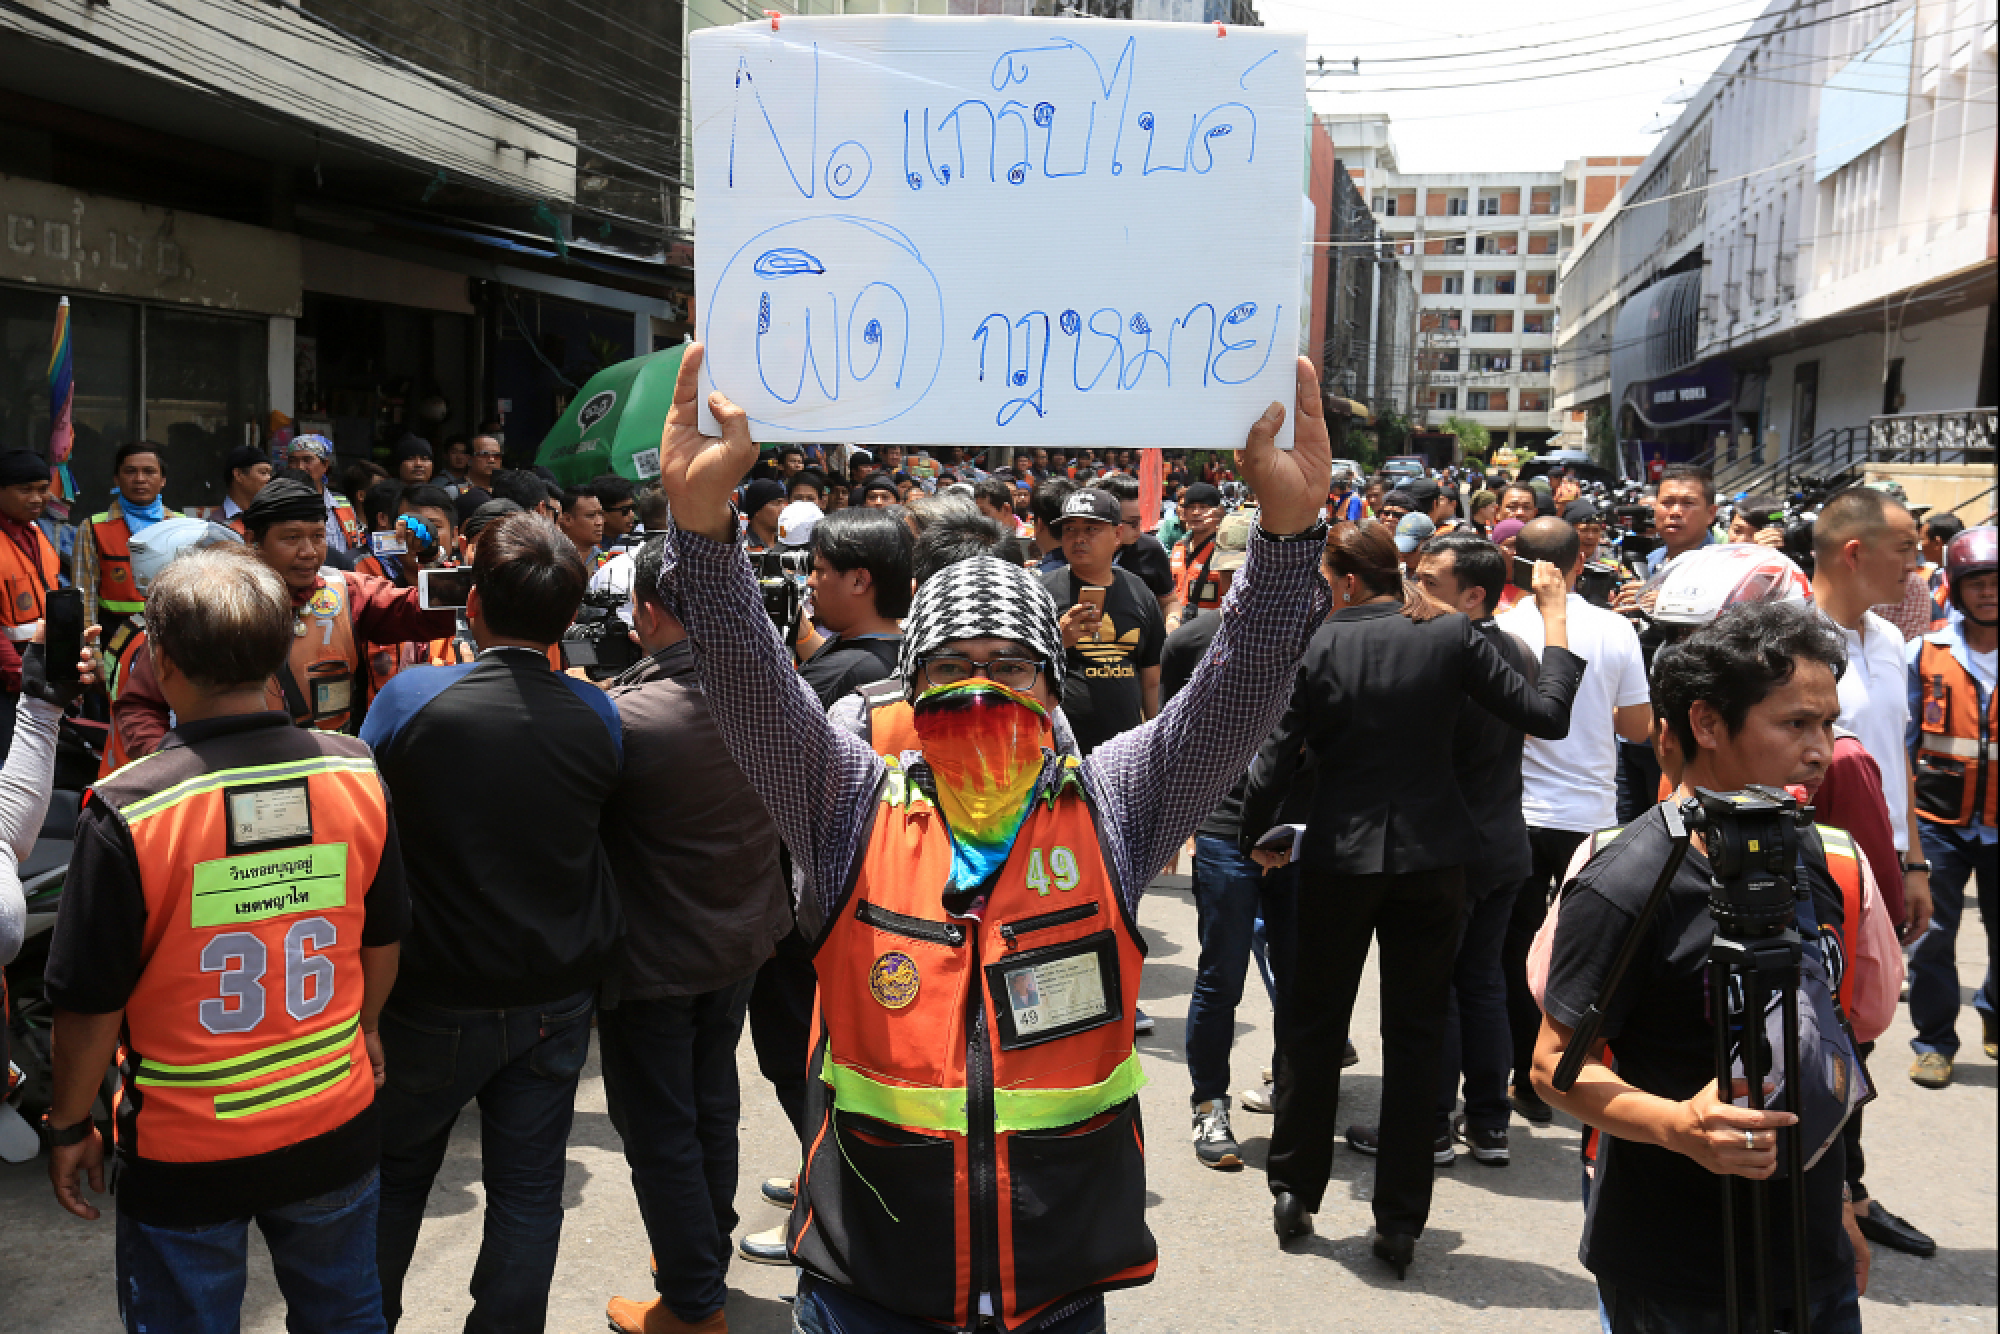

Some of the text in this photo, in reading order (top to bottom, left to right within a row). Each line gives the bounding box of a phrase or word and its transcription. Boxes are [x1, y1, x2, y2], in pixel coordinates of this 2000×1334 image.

[729, 40, 873, 200] No
[971, 301, 1283, 427] กฎหมาย
[315, 619, 335, 645] 7
[1085, 663, 1135, 678] adidas
[1026, 846, 1080, 896] 49
[235, 885, 309, 915] เขตพญาไท
[198, 915, 338, 1034] 36
[1020, 1009, 1039, 1026] 49
